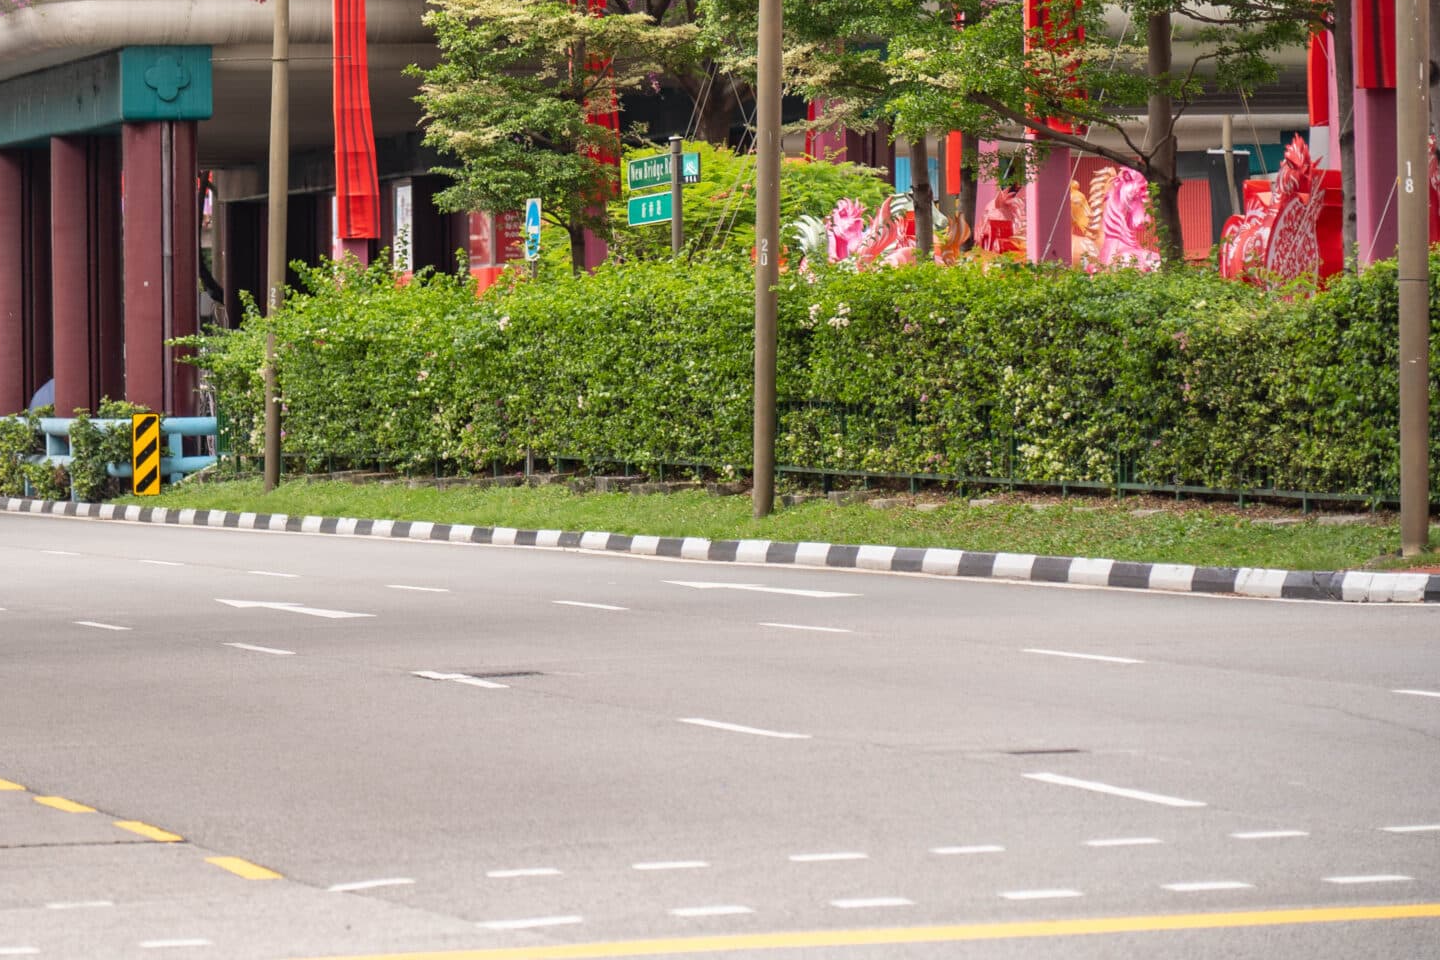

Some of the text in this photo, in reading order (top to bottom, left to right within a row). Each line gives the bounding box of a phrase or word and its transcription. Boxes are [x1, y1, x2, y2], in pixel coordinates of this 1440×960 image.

[630, 157, 672, 182] New Bridge Rd
[1405, 160, 1414, 194] 18
[761, 239, 768, 266] 20
